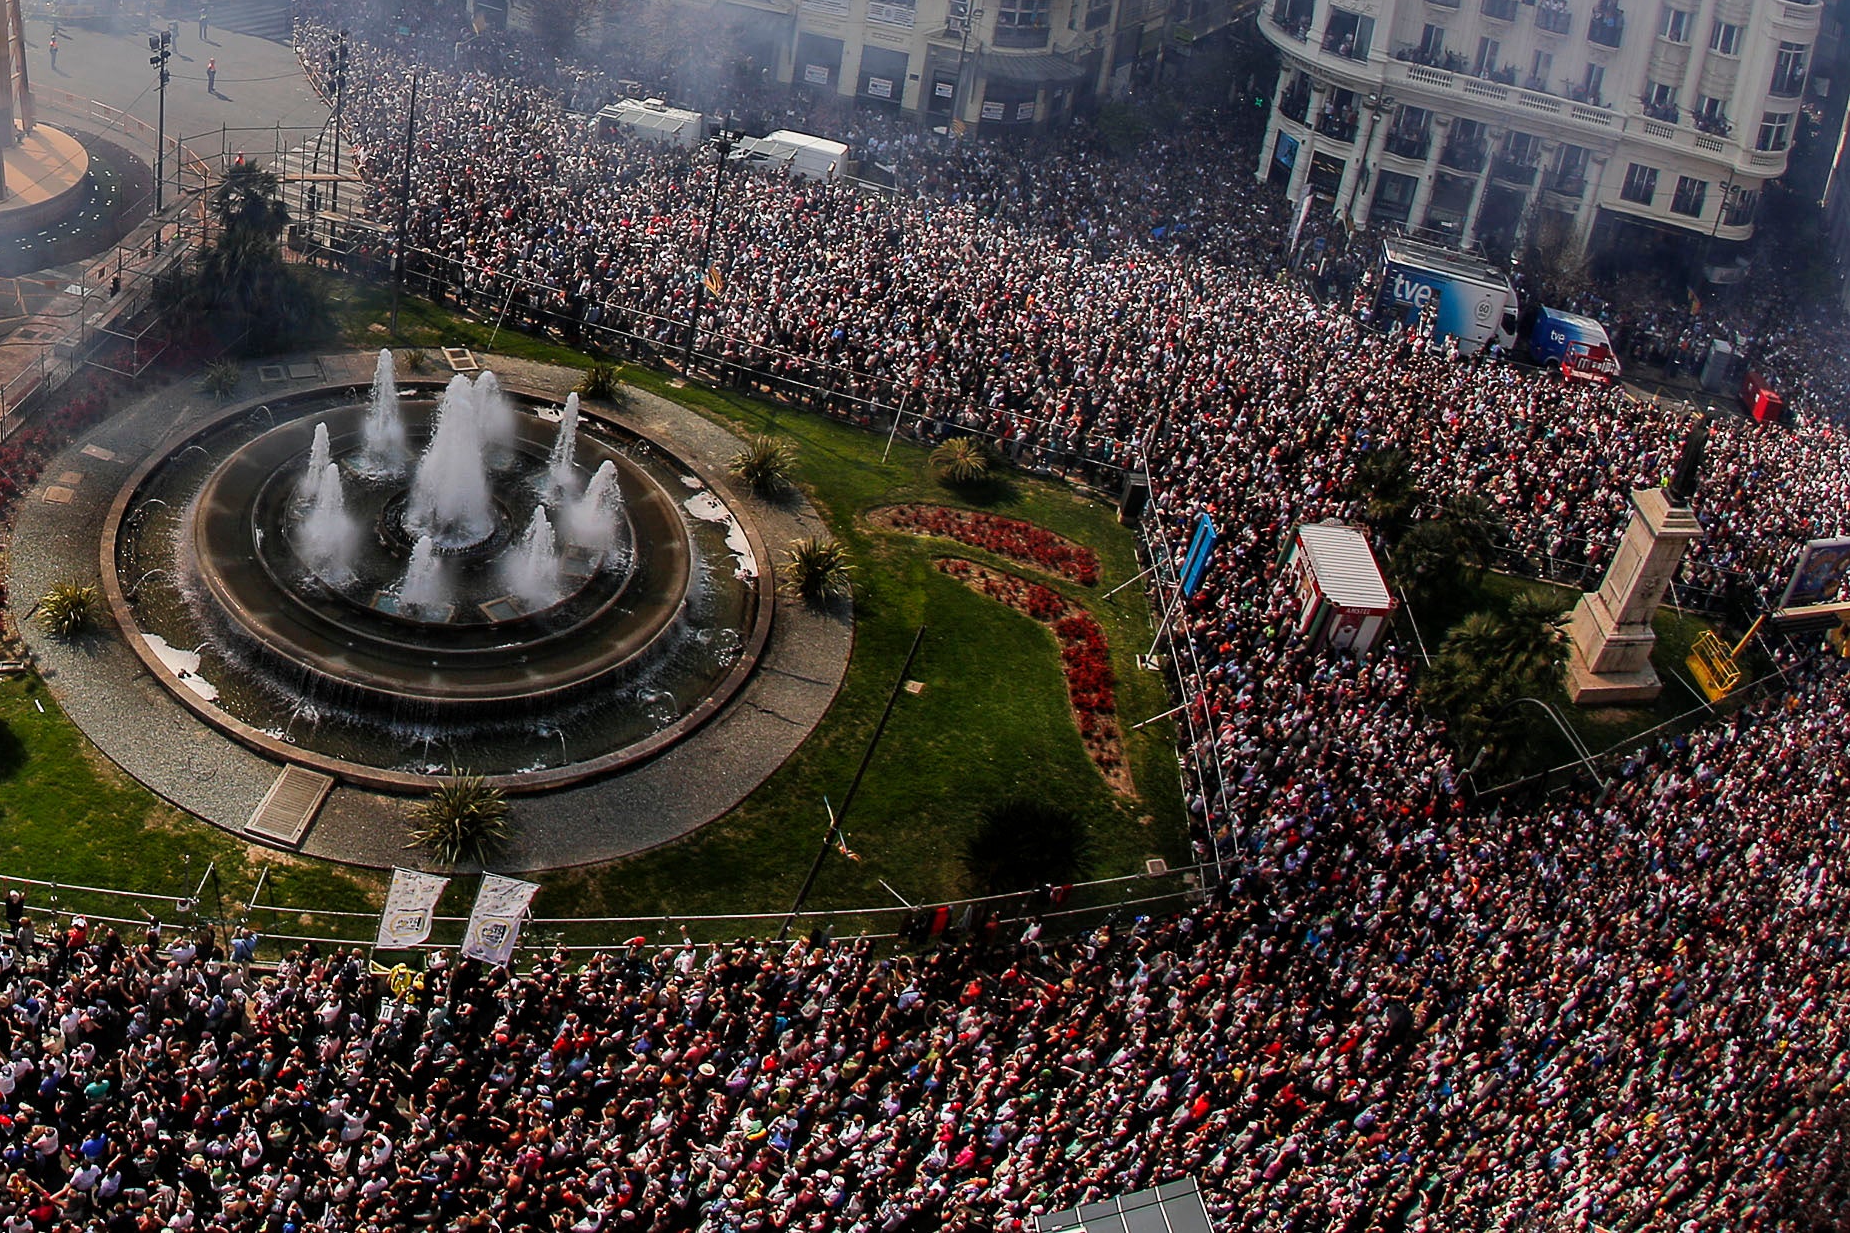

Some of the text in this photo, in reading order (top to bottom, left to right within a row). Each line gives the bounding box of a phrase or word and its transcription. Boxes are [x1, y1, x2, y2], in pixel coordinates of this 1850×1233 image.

[1393, 273, 1432, 309] tve
[1550, 329, 1566, 345] tve
[1345, 607, 1372, 615] AMSTEL
